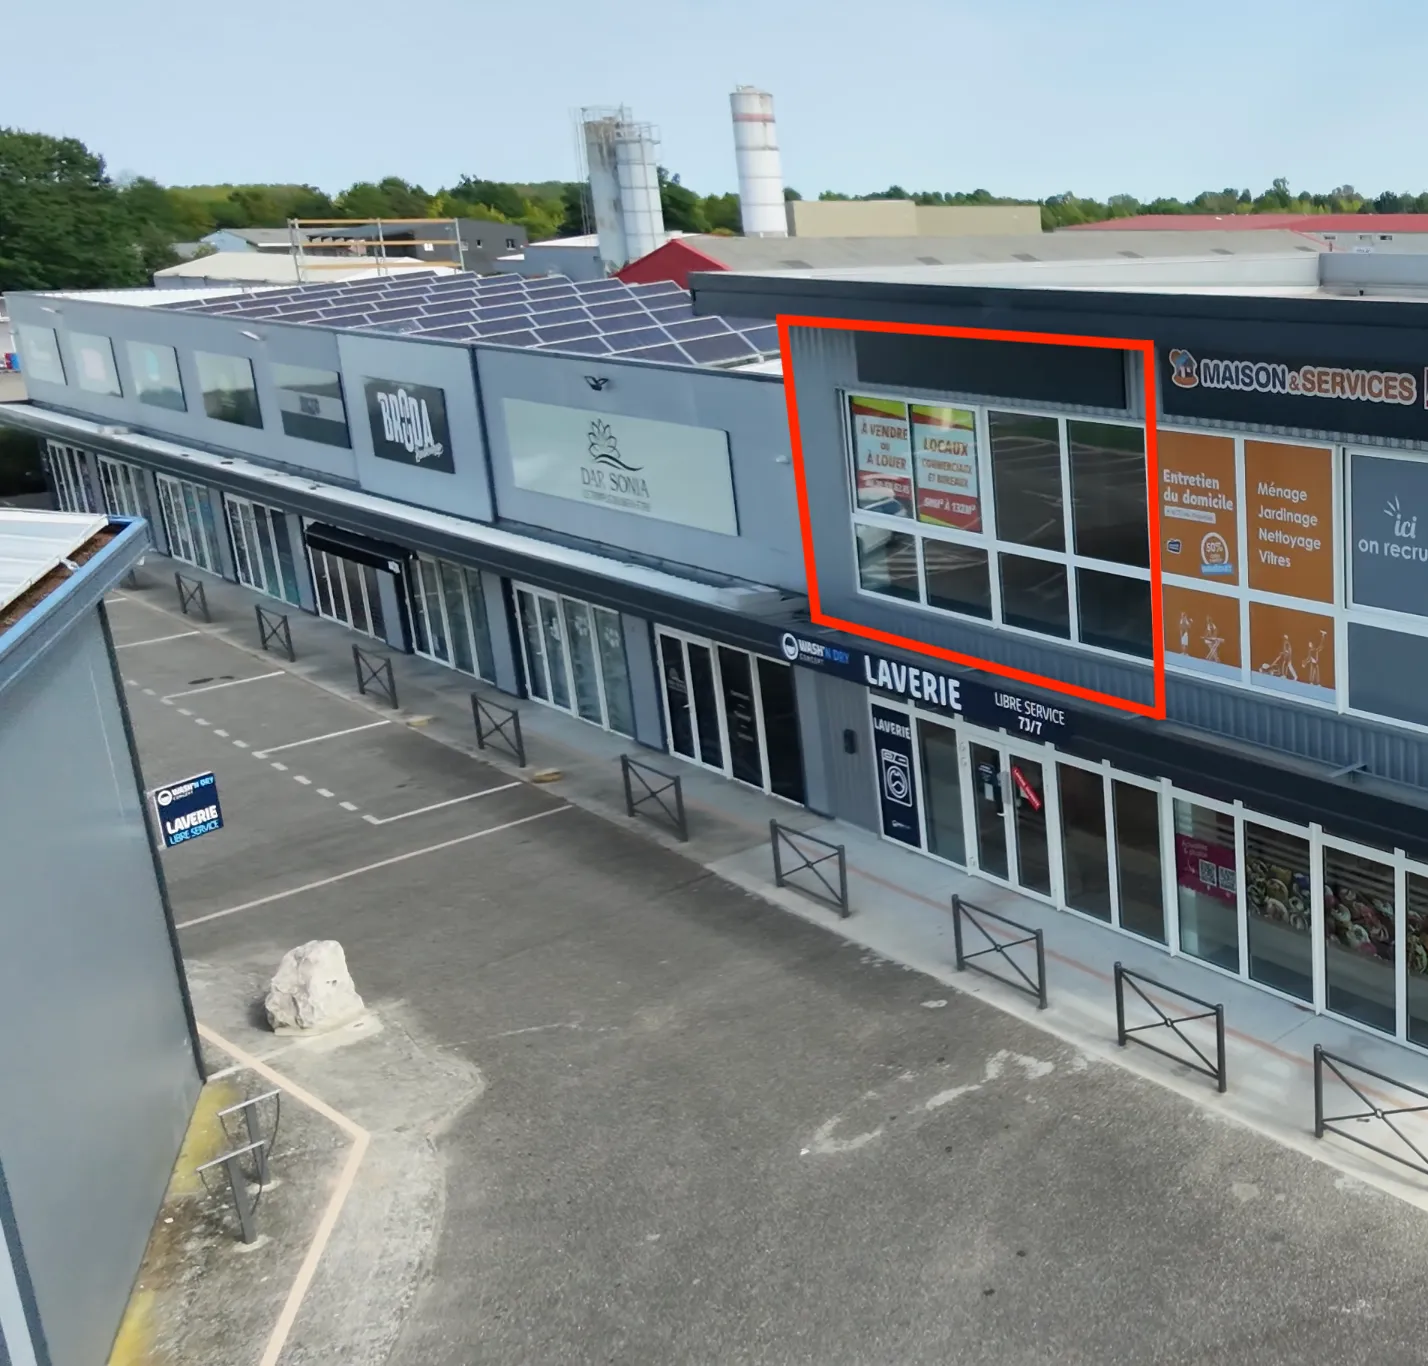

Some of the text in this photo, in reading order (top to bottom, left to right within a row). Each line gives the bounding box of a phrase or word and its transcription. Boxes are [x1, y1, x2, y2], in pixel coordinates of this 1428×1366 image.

[870, 423, 908, 440] VENDRE
[923, 436, 968, 456] LOCAUX
[876, 453, 907, 470] LOUER
[609, 472, 650, 498] SONIA
[1163, 469, 1220, 490] Entretien
[1164, 487, 1234, 511] du domicile
[1258, 481, 1307, 503] Ménage
[1258, 505, 1318, 527] Jardinage
[1394, 514, 1417, 539] ici
[1259, 527, 1321, 551] Nettoyage
[1358, 539, 1379, 554] on
[1259, 550, 1291, 568] Vitres
[864, 654, 963, 711] LAVERIE
[994, 691, 1066, 726] LIBRE SERVICE
[873, 717, 912, 740] LAVERIE
[166, 805, 219, 835] LAVERIE
[169, 819, 219, 845] LIBRE SERVICE
